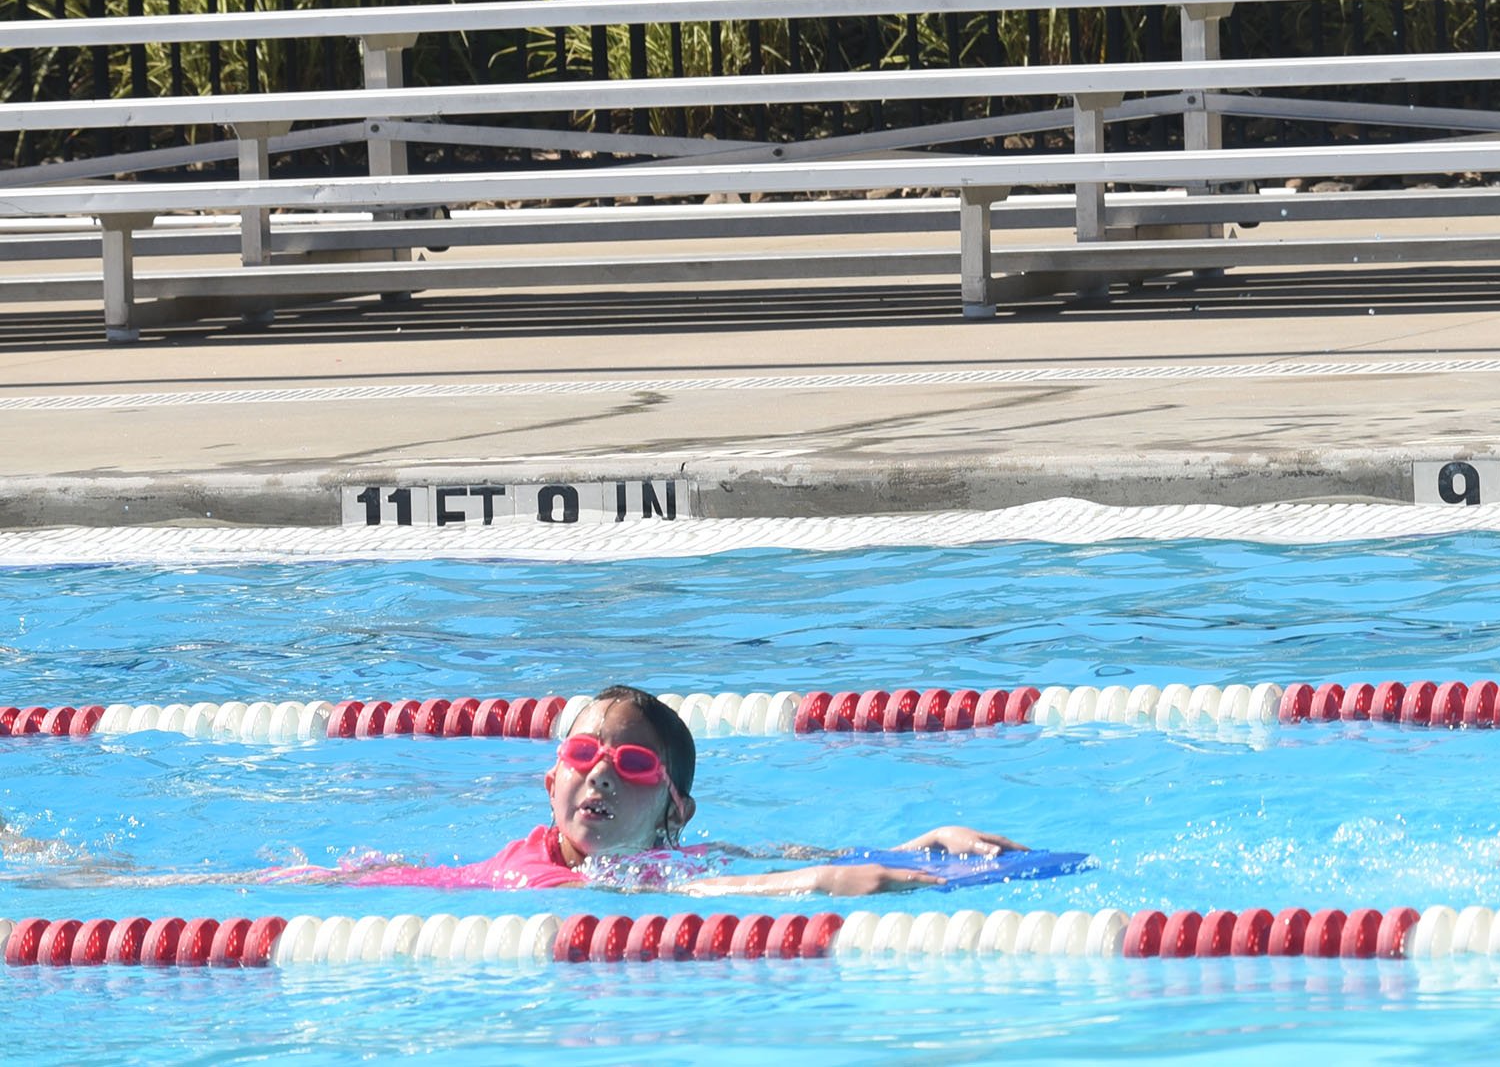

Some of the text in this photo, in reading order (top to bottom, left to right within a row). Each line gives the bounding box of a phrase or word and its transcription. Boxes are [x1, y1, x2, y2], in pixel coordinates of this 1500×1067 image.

[357, 487, 412, 526] 11
[436, 485, 505, 526] FT
[615, 480, 676, 521] IN
[1438, 461, 1480, 505] 9
